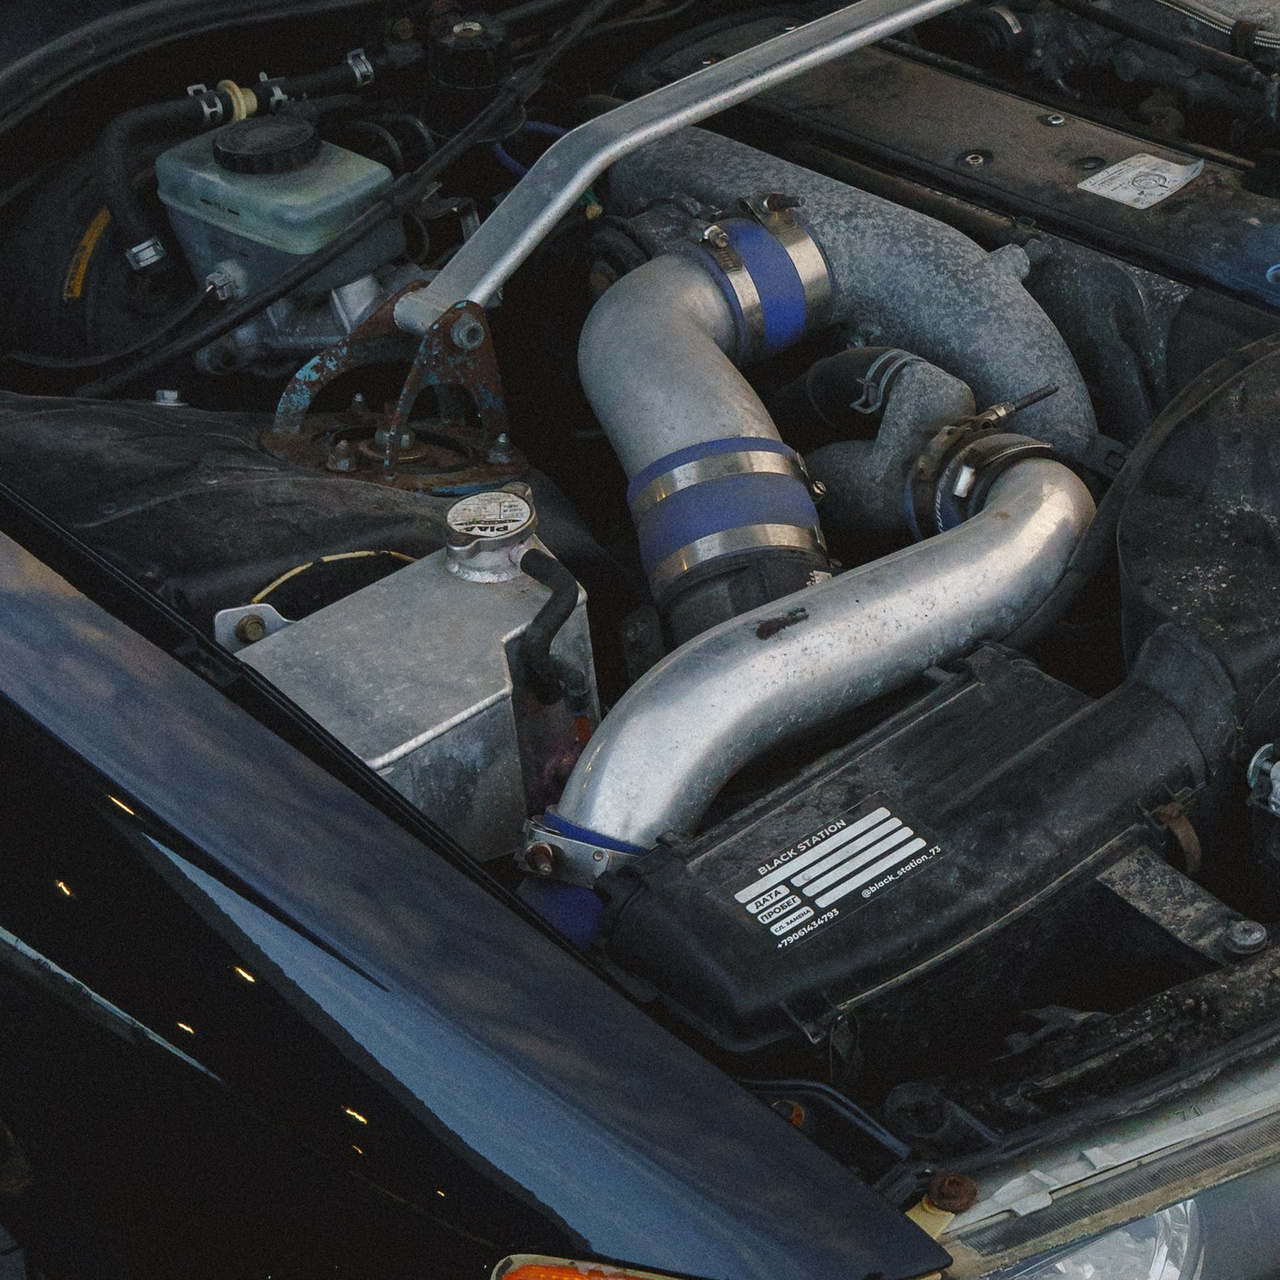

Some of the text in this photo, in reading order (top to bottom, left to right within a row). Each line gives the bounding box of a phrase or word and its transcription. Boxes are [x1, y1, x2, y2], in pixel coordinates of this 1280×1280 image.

[758, 818, 847, 876] BLACK STATION
[861, 845, 942, 899] @black_station_73
[753, 888, 783, 910] ДАТА
[760, 895, 799, 922] ПРОБЕГ
[776, 908, 840, 949] +79061434793
[786, 909, 811, 928] ЗАМЕНА
